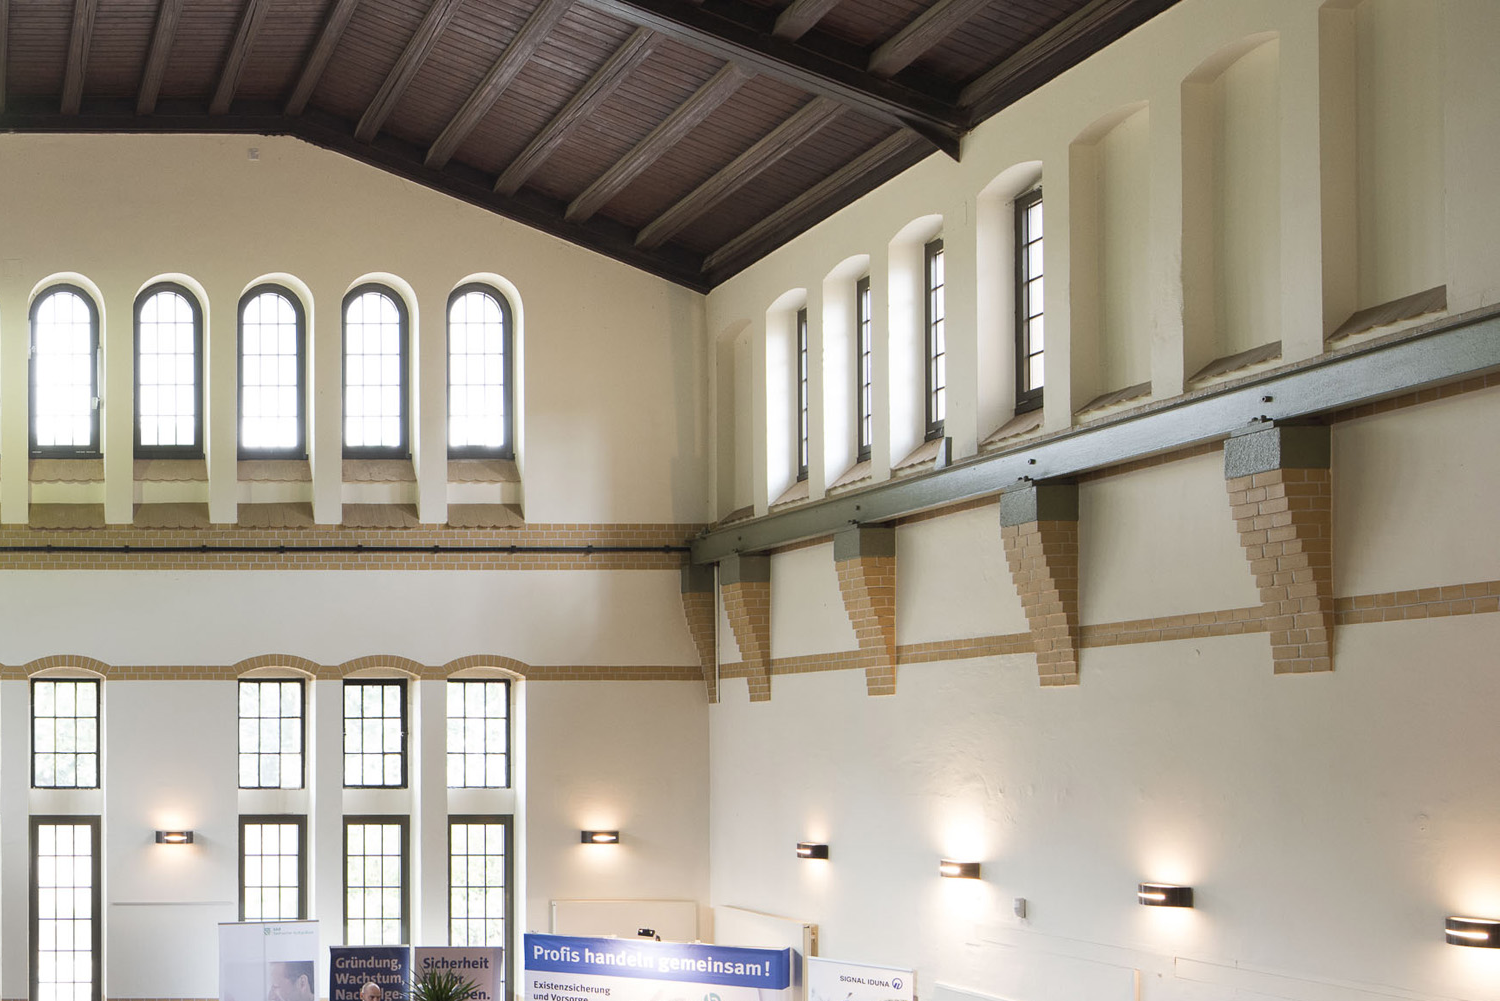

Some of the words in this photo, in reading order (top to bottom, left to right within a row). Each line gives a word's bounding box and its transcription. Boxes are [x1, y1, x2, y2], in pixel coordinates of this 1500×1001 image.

[335, 956, 402, 971] Gründung,
[423, 957, 489, 969] Sicherheit
[533, 945, 580, 963] Profis
[584, 947, 654, 968] handeln
[335, 972, 405, 986] Wachstum,
[839, 975, 866, 985] SIGNAL
[867, 979, 890, 988] IDUNA
[533, 980, 611, 996] Existenzsicherung
[533, 992, 549, 1001] und
